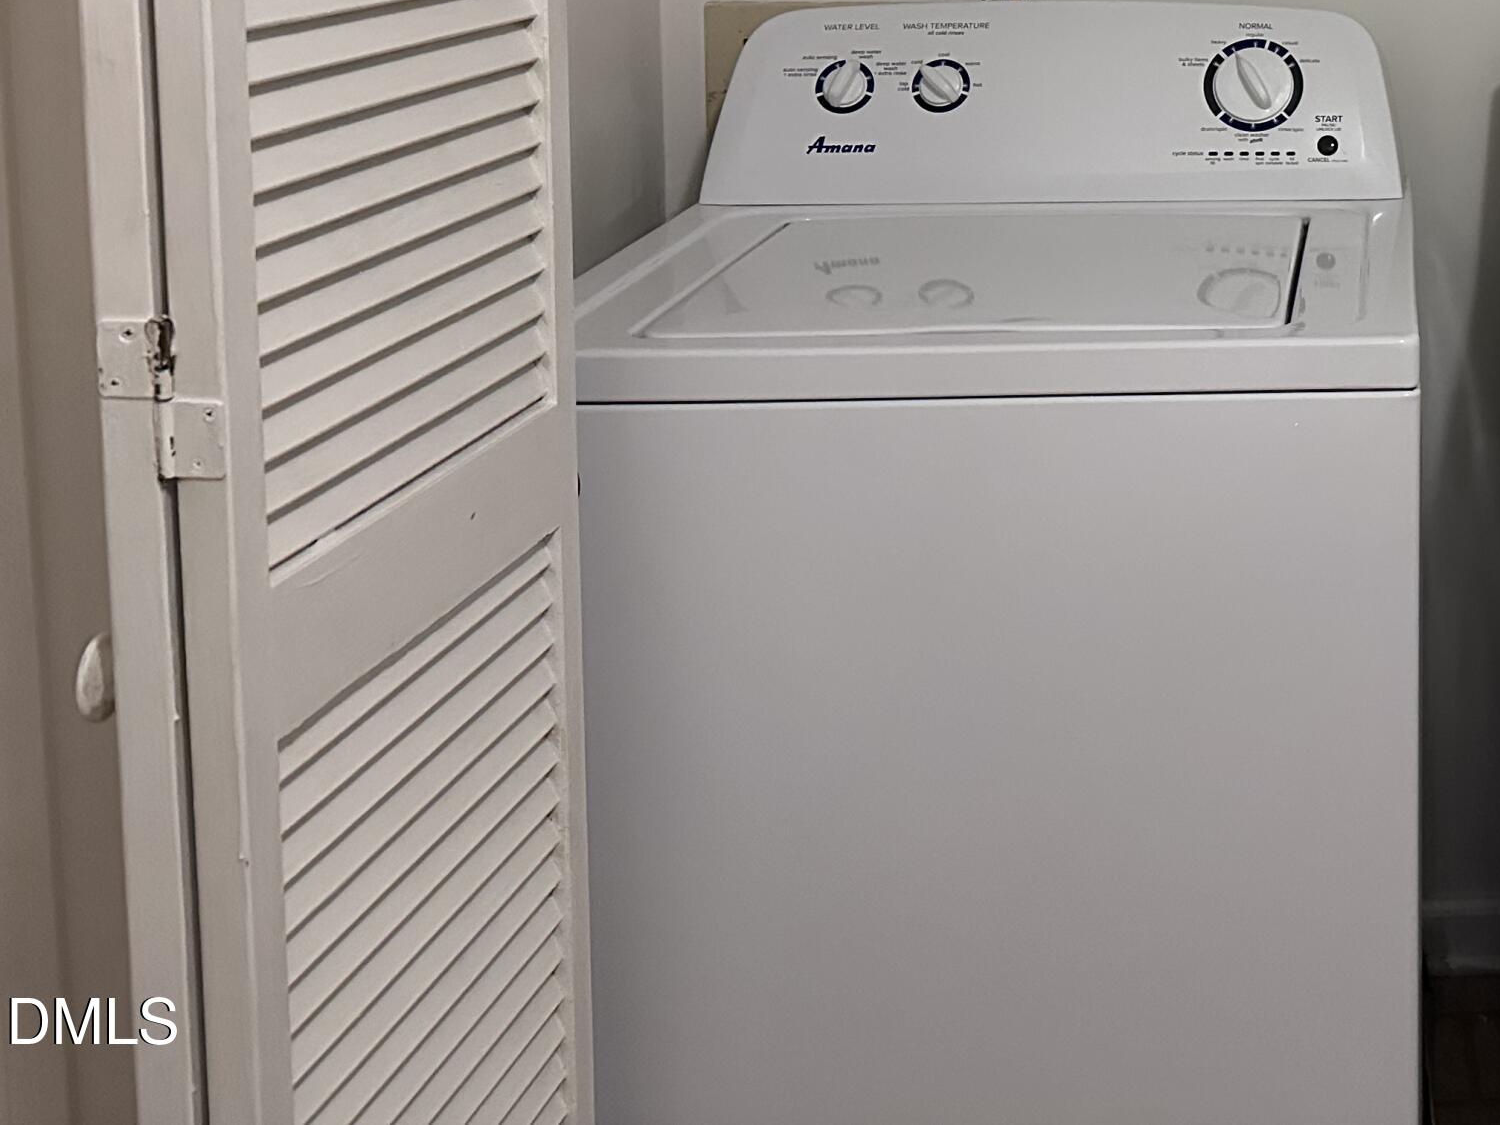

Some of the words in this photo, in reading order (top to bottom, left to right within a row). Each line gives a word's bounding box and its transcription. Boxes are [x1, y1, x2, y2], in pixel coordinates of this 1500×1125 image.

[824, 23, 853, 31] WATER
[930, 22, 990, 30] TEMPERATURE
[1238, 22, 1273, 30] NORMAL
[1315, 115, 1343, 123] START
[806, 135, 877, 155] Amana
